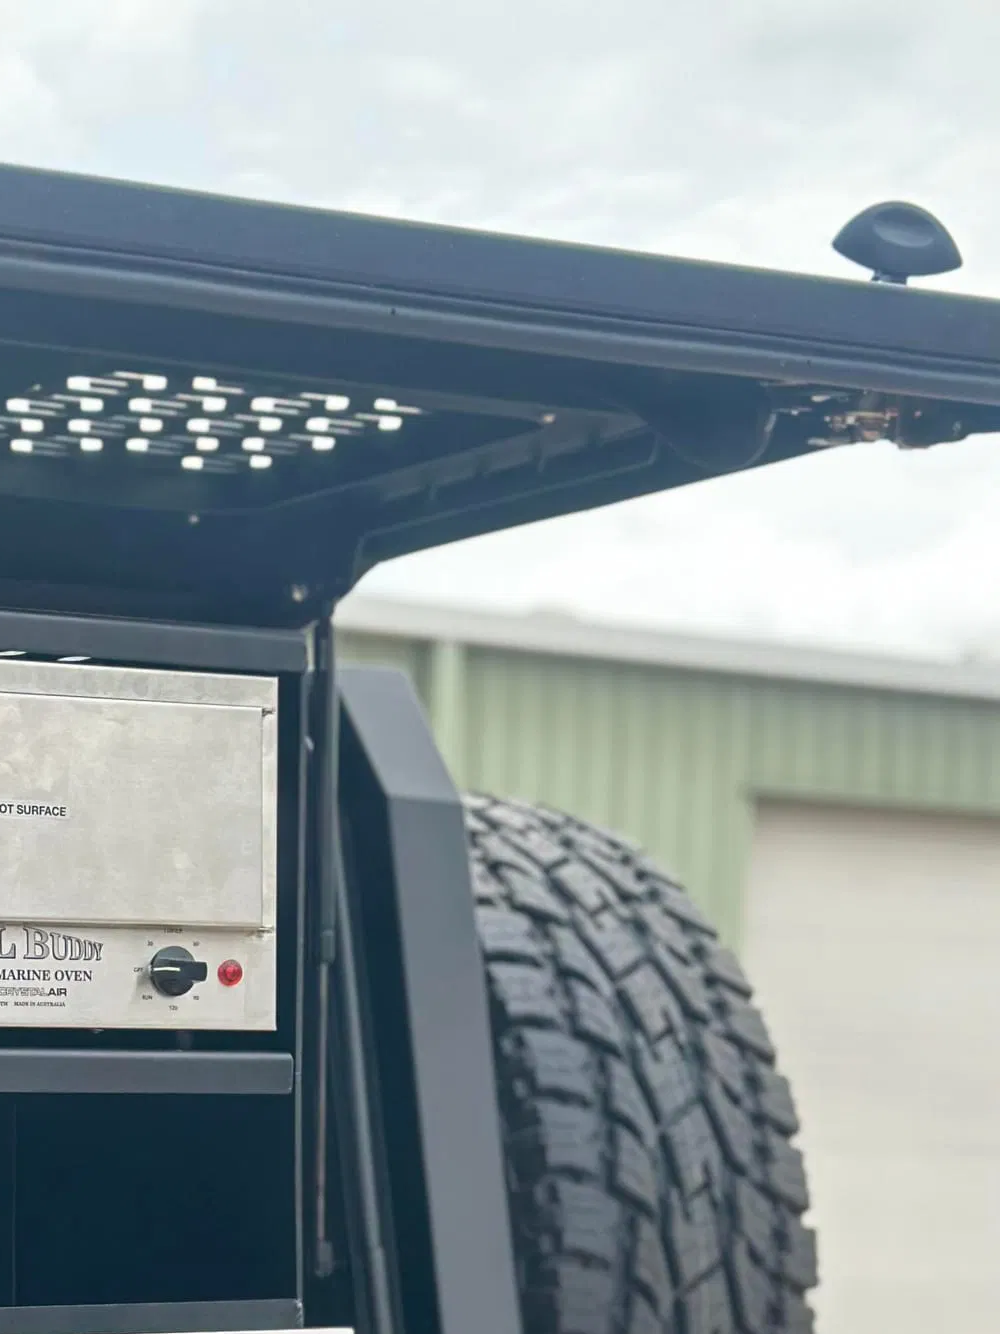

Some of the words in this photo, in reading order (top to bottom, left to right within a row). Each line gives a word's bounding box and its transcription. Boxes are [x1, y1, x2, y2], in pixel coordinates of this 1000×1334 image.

[16, 804, 67, 816] SURFACE
[22, 926, 104, 961] BUDDY
[54, 970, 92, 982] OVEN
